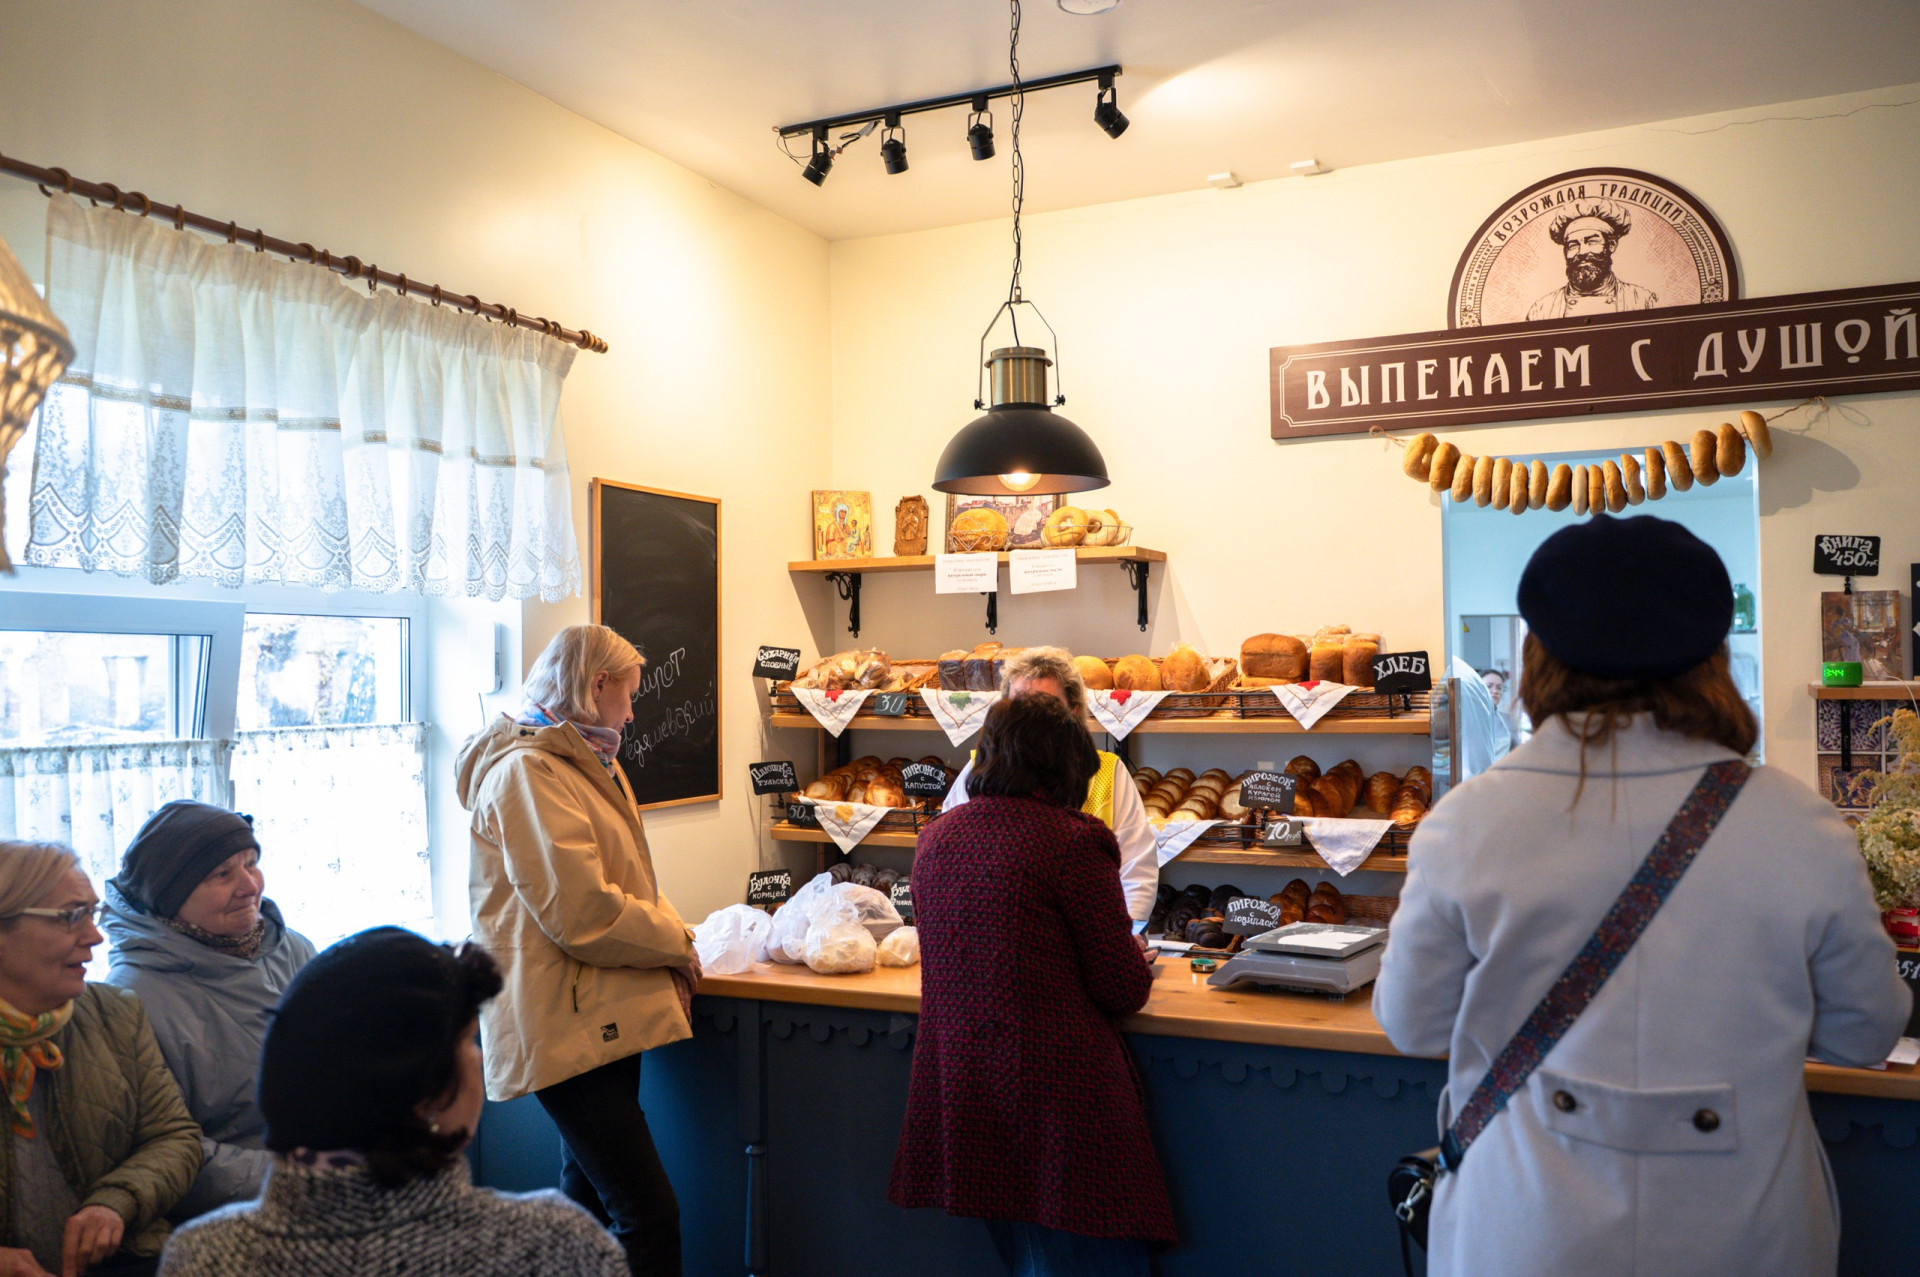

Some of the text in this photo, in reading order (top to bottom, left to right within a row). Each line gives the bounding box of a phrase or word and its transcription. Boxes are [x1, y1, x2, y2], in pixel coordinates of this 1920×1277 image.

[1494, 183, 1684, 242] ВОЗРОЖДАЯ ТРАДИЦИИ
[1306, 308, 1919, 410] ВЫПЕКАЕМ С ДУШОЙ
[1830, 550, 1867, 566] 450
[1373, 655, 1426, 681] ХЛЕБ
[788, 805, 806, 819] 50
[1266, 822, 1290, 840] 70
